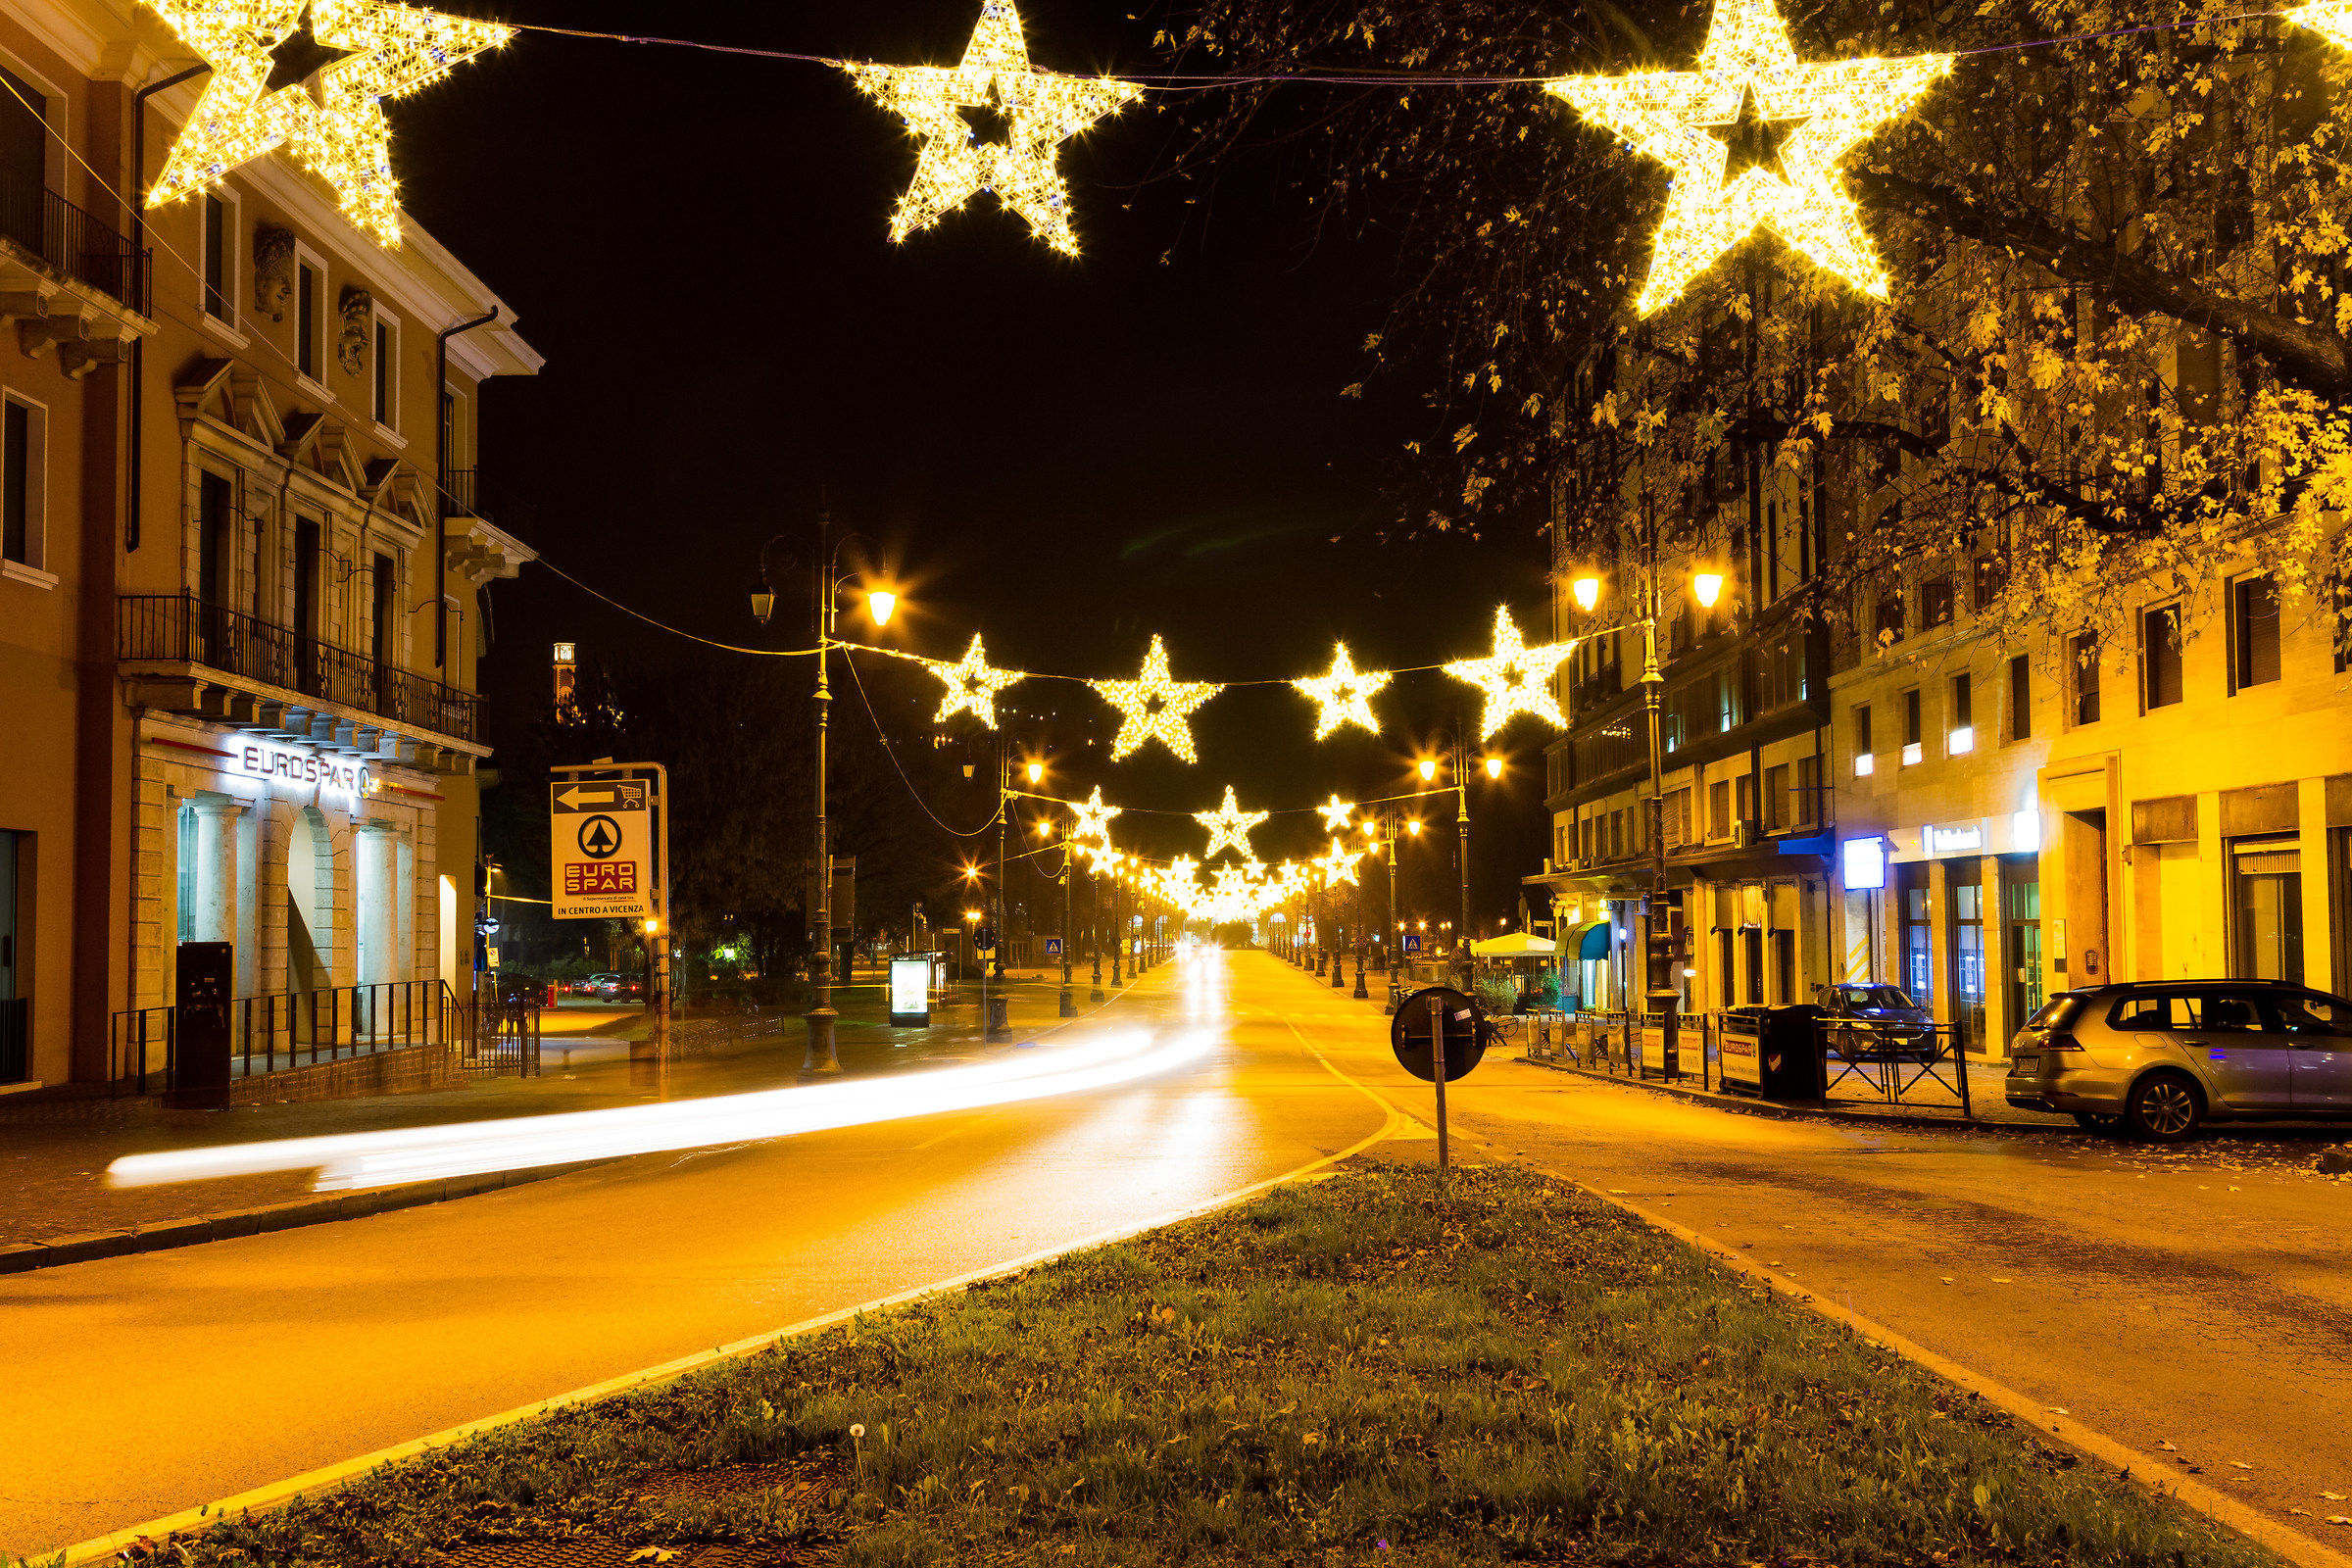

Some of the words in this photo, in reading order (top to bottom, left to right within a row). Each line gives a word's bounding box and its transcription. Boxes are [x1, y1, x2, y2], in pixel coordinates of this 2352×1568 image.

[244, 746, 355, 790] EUROSPAR
[565, 863, 633, 877] EURO
[566, 877, 633, 892] SPAR
[609, 905, 644, 913] VICENZA
